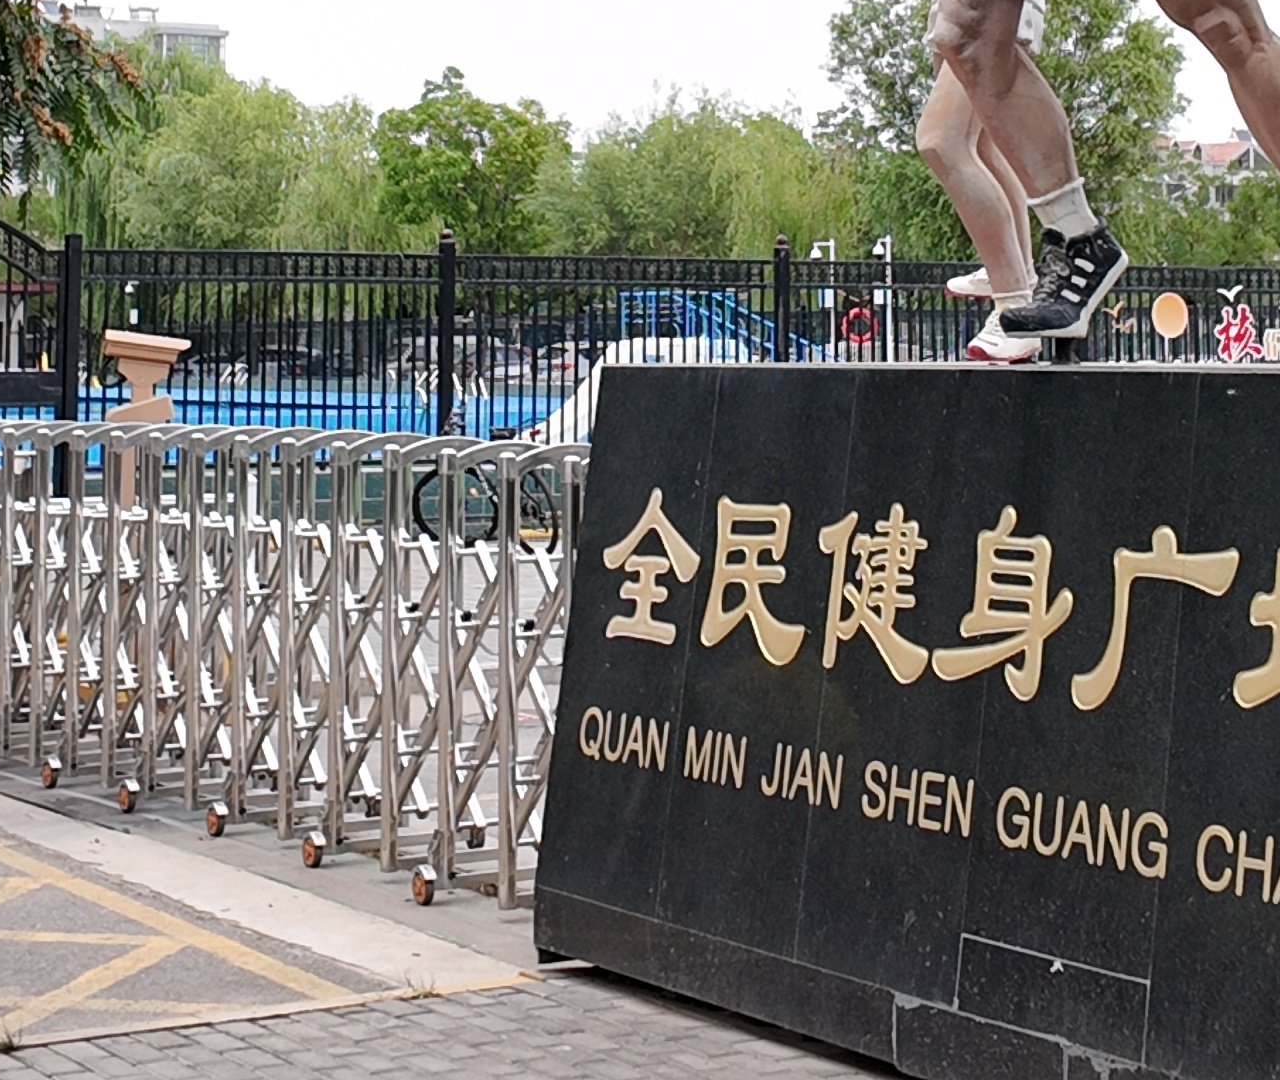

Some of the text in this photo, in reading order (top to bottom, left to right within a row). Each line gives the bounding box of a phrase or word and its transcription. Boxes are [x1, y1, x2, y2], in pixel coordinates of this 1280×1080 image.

[1215, 305, 1264, 362] 核
[579, 707, 669, 772] QUAN
[684, 727, 747, 789] MIN
[761, 742, 844, 810] JIAN
[861, 761, 975, 837] SHEN
[996, 787, 1169, 878] GUANG
